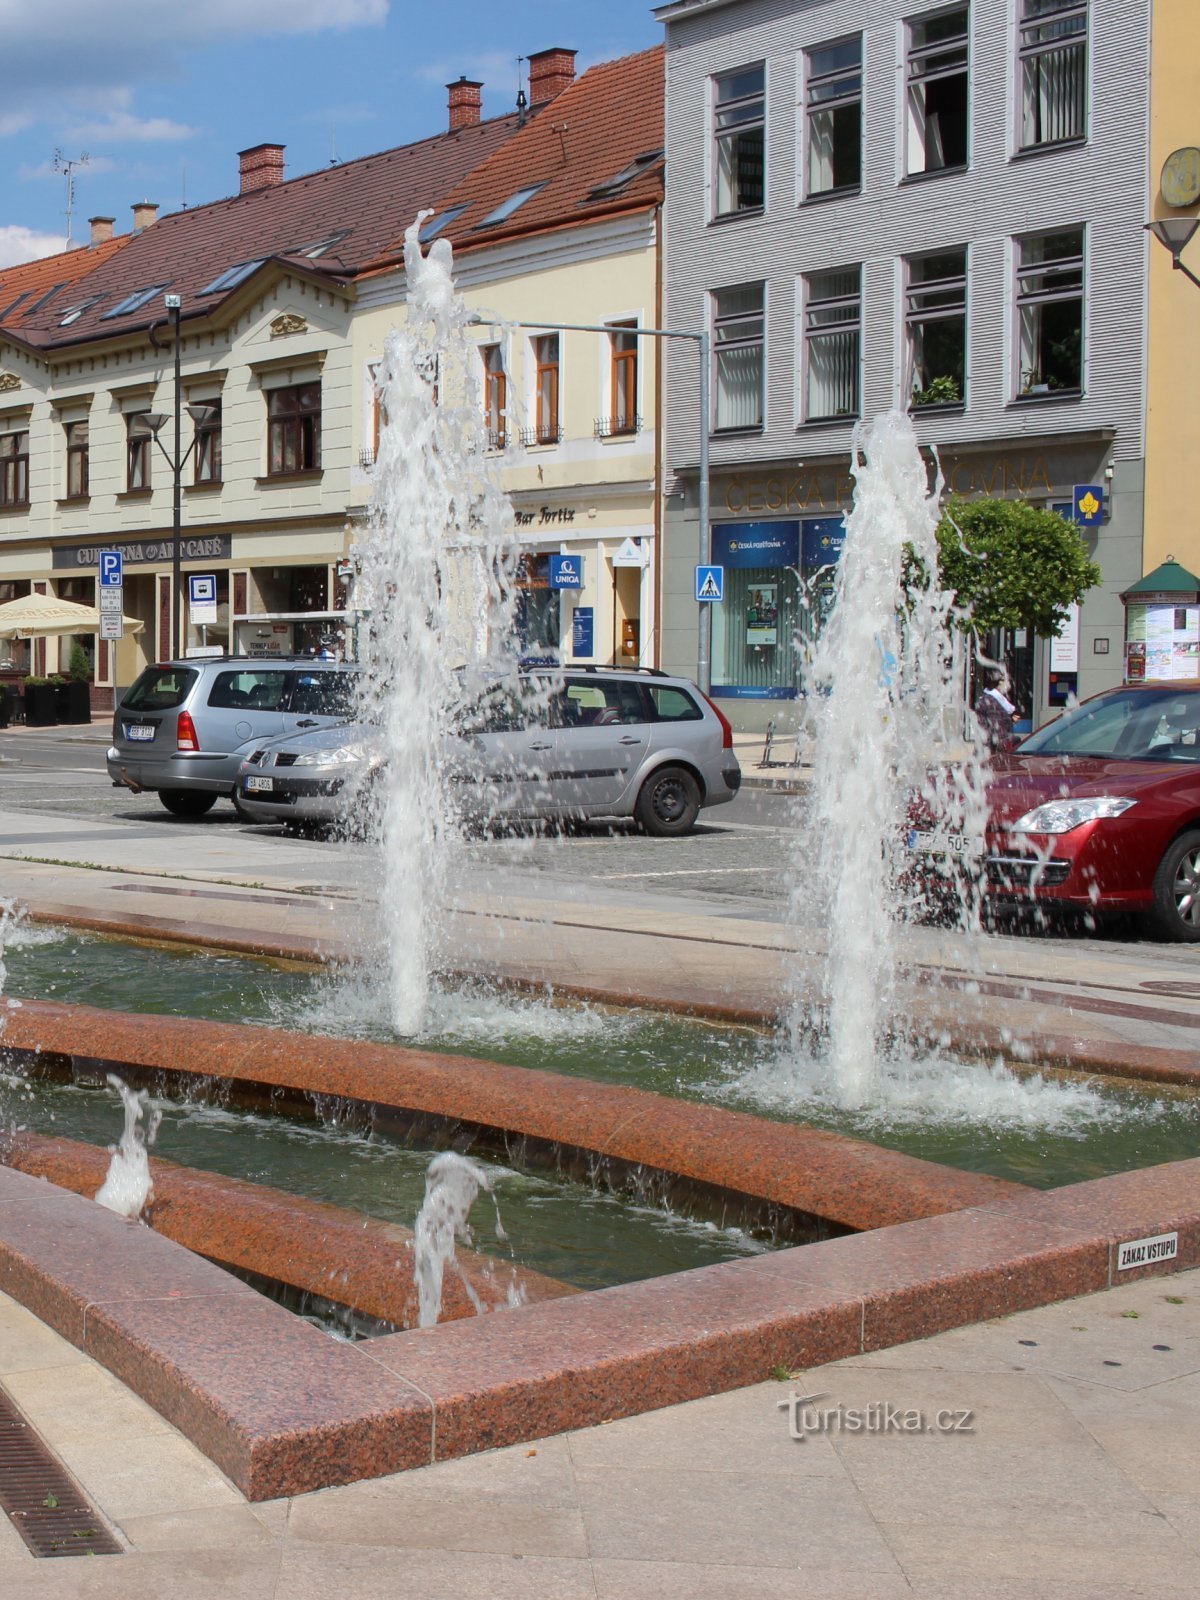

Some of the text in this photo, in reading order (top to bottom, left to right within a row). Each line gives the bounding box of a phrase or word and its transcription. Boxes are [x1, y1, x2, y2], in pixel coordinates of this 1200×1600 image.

[726, 467, 825, 513] ČESKÁ
[514, 511, 535, 526] Bar
[187, 536, 221, 557] CAFÉ
[738, 541, 753, 549] ČESKÁ
[104, 555, 118, 576] P
[555, 575, 580, 584] UNIQA
[1122, 1239, 1176, 1265] ZÁKAZ VSTUPU
